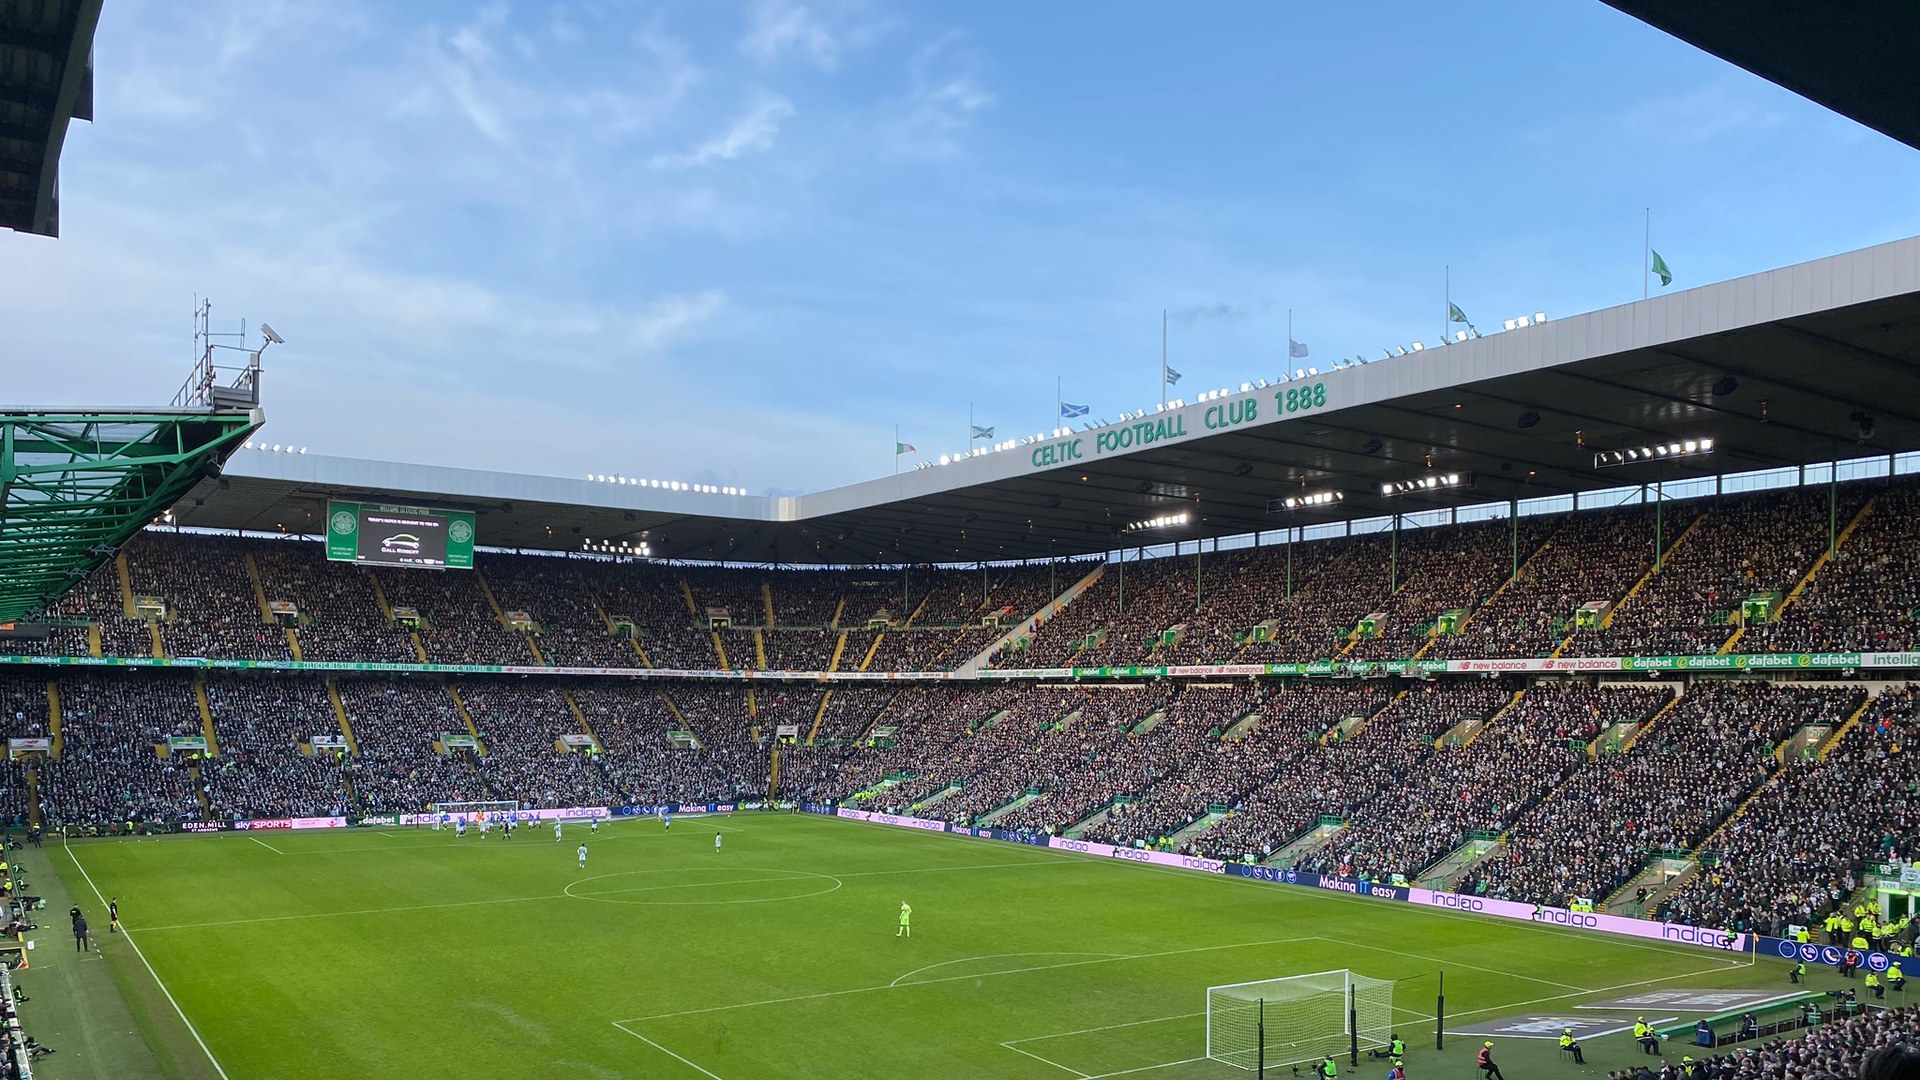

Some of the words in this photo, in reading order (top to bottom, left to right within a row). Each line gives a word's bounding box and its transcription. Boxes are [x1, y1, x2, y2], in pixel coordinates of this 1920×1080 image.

[1032, 438, 1083, 468] CELTIC
[1096, 414, 1188, 455] FOOTBALL
[1204, 398, 1258, 430] CLUB
[1274, 382, 1328, 416] 1888
[126, 658, 153, 666] dafabet
[1558, 661, 1577, 669] new
[1578, 659, 1617, 669] balance
[1634, 657, 1672, 668] dafabet
[1689, 656, 1730, 667] dafabet
[1748, 654, 1793, 667] dafabet
[1812, 653, 1860, 665] dafabet
[1190, 666, 1213, 674] balance
[1239, 665, 1263, 673] balance
[1273, 665, 1296, 673] dafabet
[1306, 664, 1331, 673] dafabet
[1492, 661, 1527, 670] balance
[566, 808, 601, 818] indigo
[678, 803, 706, 813] Making
[708, 803, 715, 812] IT
[717, 804, 734, 812] easy
[234, 820, 251, 831] sky
[253, 819, 291, 829] SPORTS
[362, 815, 395, 824] dafabet
[951, 823, 971, 836] Making
[972, 826, 978, 835] IT
[979, 830, 992, 839] easy
[1060, 838, 1088, 852] indigo
[1183, 854, 1218, 871] indigo
[1319, 875, 1356, 895] Making
[1359, 881, 1369, 893] IT
[1372, 886, 1396, 900] easy
[1432, 890, 1483, 912] indigo
